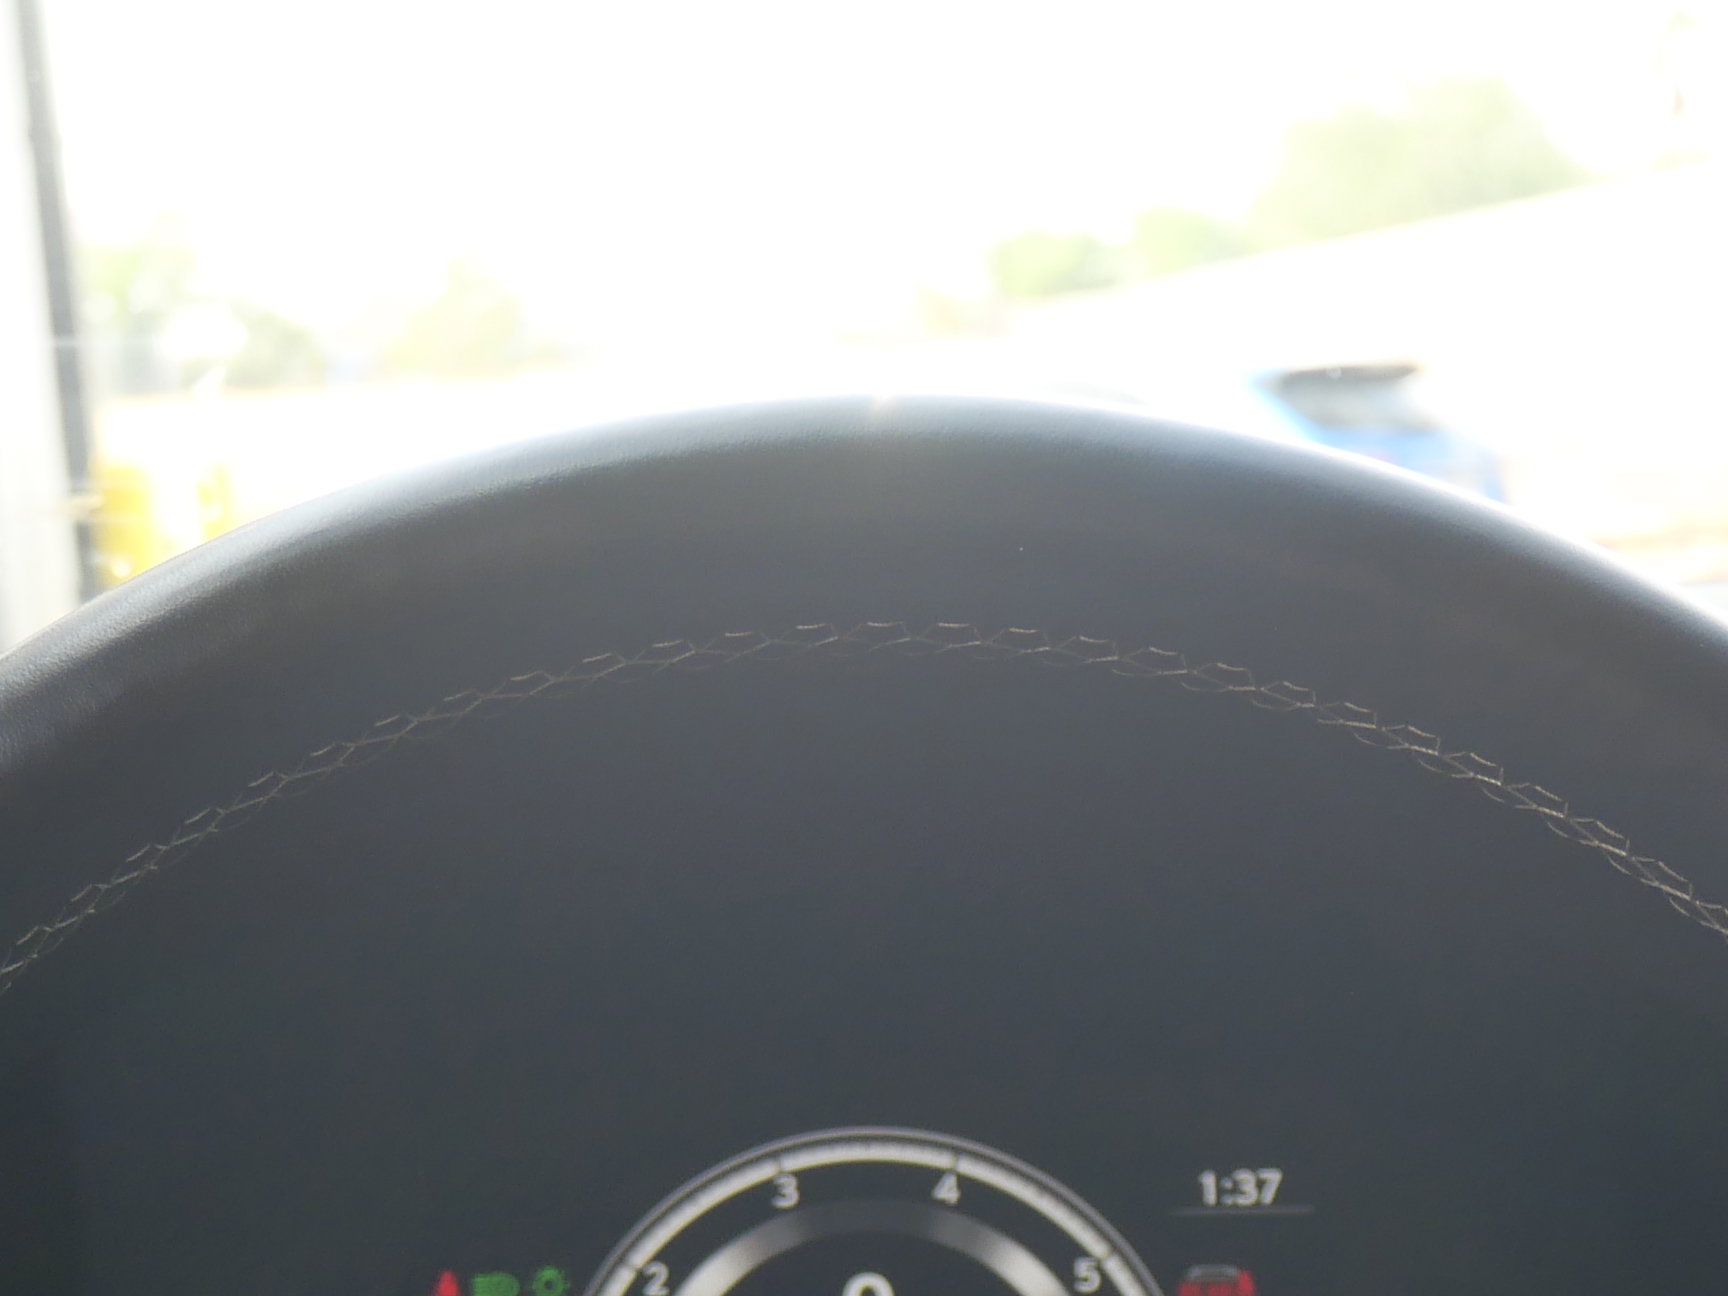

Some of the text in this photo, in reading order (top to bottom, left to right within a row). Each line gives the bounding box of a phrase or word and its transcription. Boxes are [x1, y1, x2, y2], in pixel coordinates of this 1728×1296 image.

[773, 1173, 799, 1208] 3
[933, 1172, 960, 1204] 4
[1198, 1168, 1282, 1207] 1:37
[1074, 1258, 1101, 1294] 5
